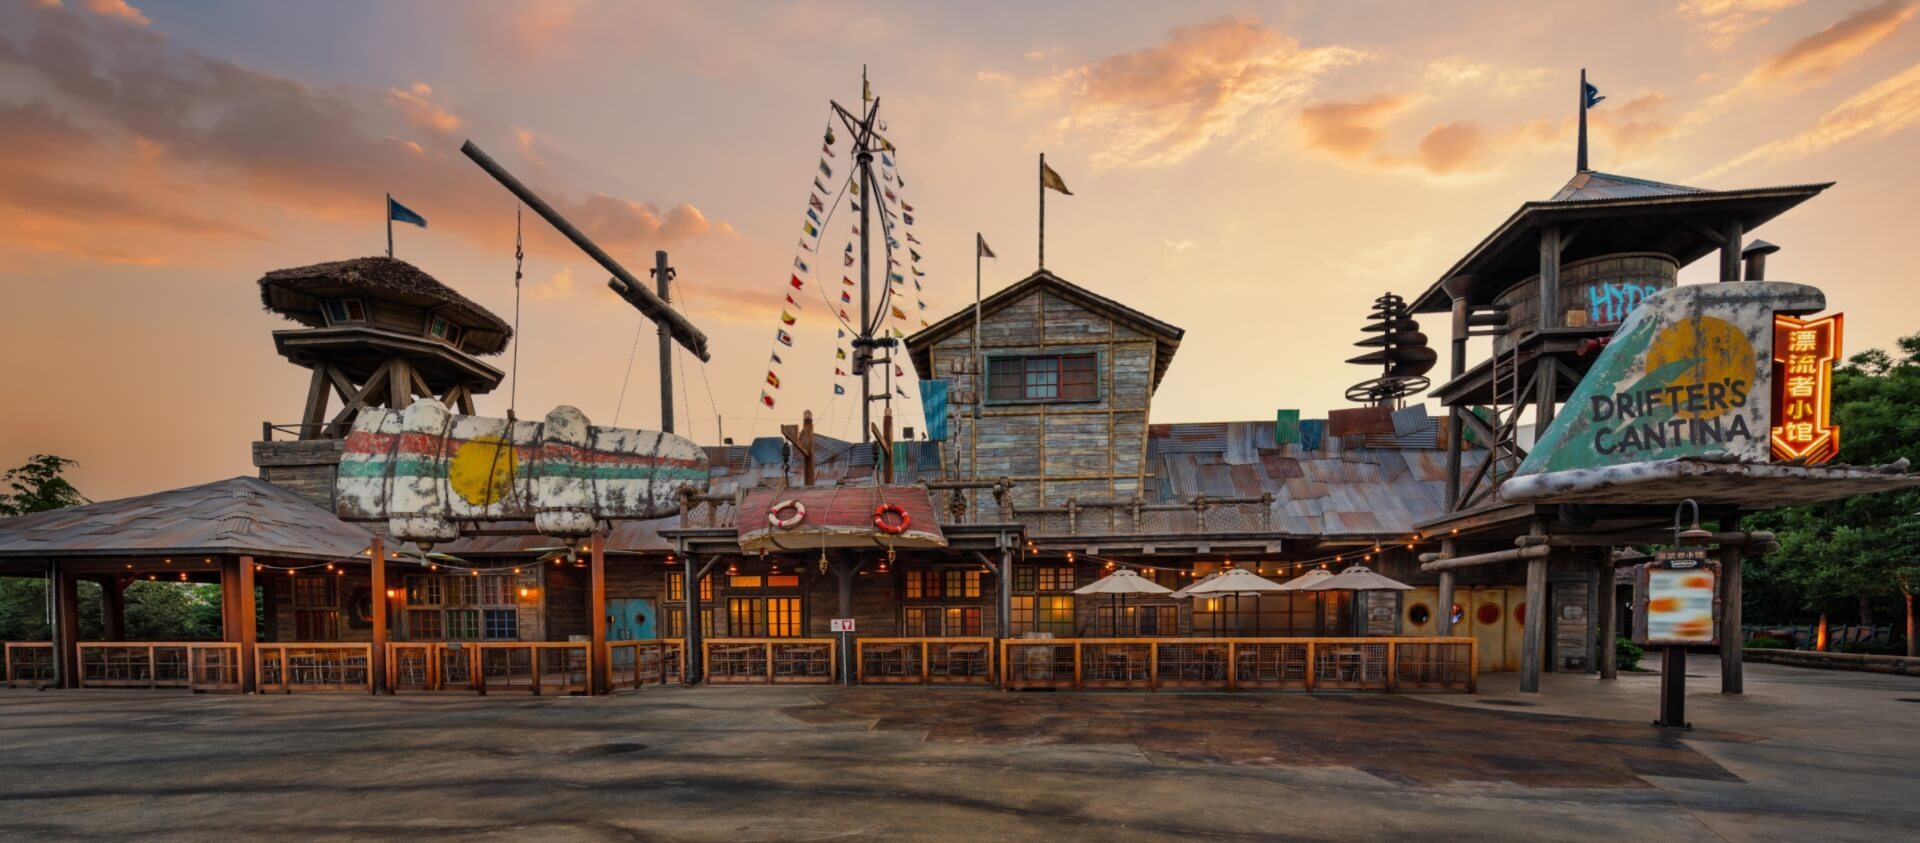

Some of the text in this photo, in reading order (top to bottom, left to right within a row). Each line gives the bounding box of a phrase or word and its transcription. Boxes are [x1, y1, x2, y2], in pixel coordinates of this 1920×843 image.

[1590, 377, 1747, 422] DRIFTER'S
[1787, 330, 1817, 442] 漂流者小馆
[1595, 414, 1751, 455] CANTINA
